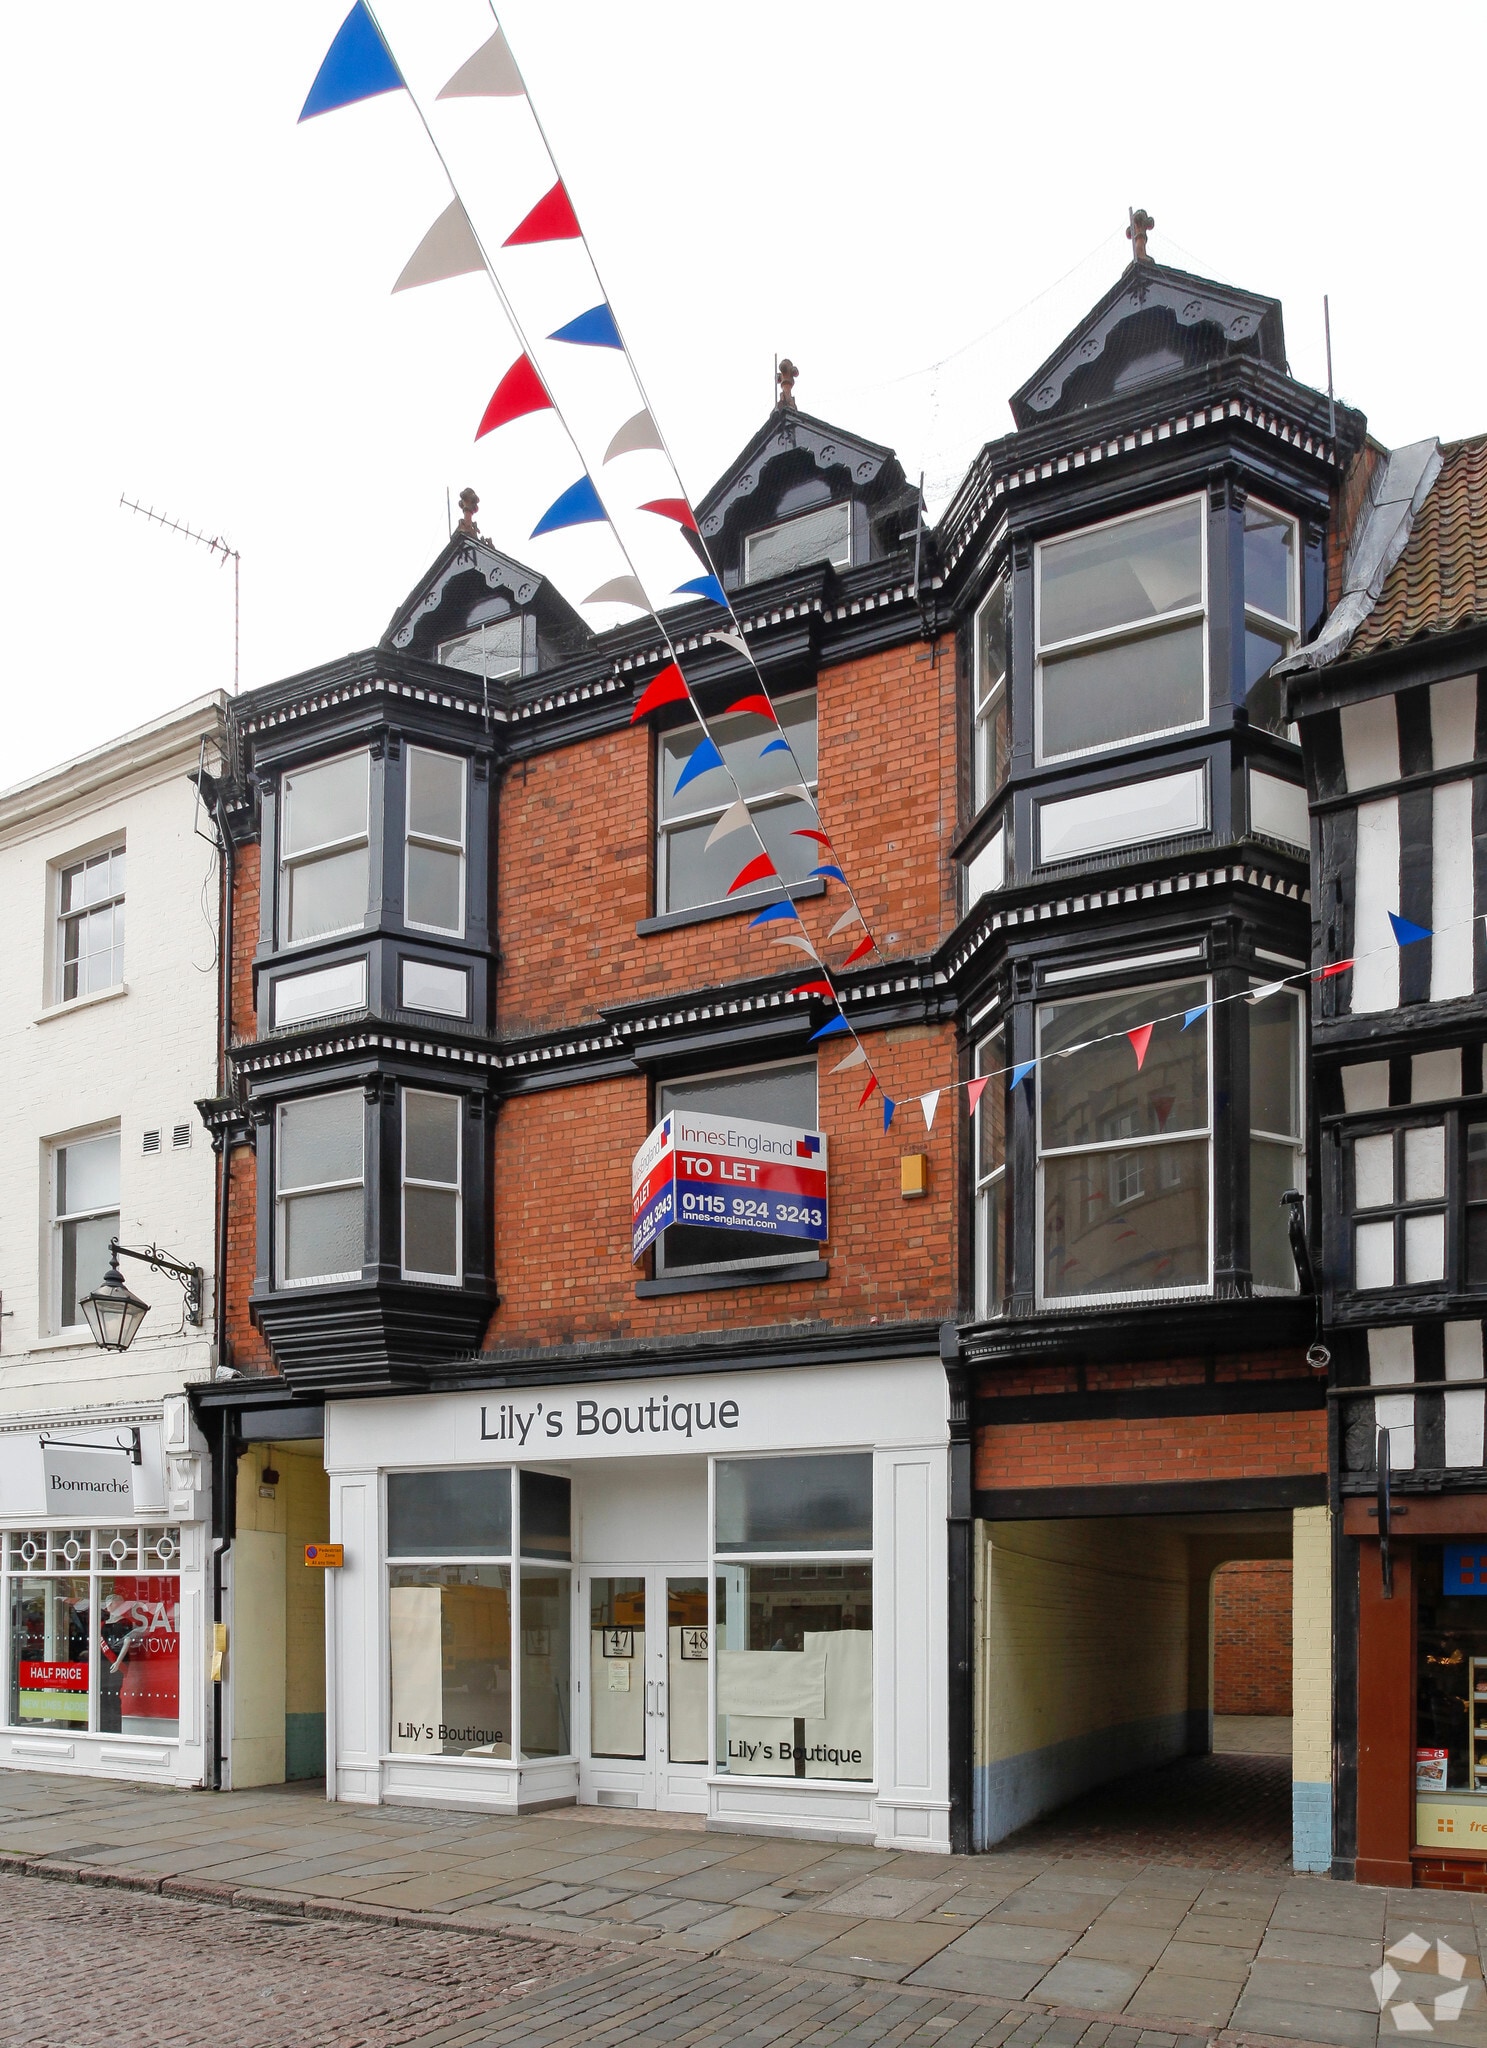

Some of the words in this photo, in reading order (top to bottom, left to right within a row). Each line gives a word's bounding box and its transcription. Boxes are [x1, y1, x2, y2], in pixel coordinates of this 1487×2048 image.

[682, 1125, 793, 1156] InnesEngland
[682, 1156, 713, 1177] TO
[720, 1160, 760, 1182] LET
[633, 1196, 640, 1216] TO
[640, 1180, 651, 1205] LET
[682, 1193, 725, 1214] 0115
[732, 1199, 769, 1218] 924
[776, 1205, 822, 1226] 3243
[642, 1213, 654, 1238] 924
[654, 1193, 672, 1223] 3243
[682, 1211, 777, 1230] innes-england.com
[480, 1402, 564, 1446] Lily's
[576, 1394, 740, 1438] Boutique
[50, 1474, 130, 1494] Bonmarché
[138, 1637, 176, 1653] NOW
[611, 1630, 629, 1648] 47
[30, 1667, 54, 1679] HALF
[55, 1668, 82, 1680] PRICE
[437, 1724, 503, 1746] Boutique
[779, 1742, 862, 1766] Boutique
